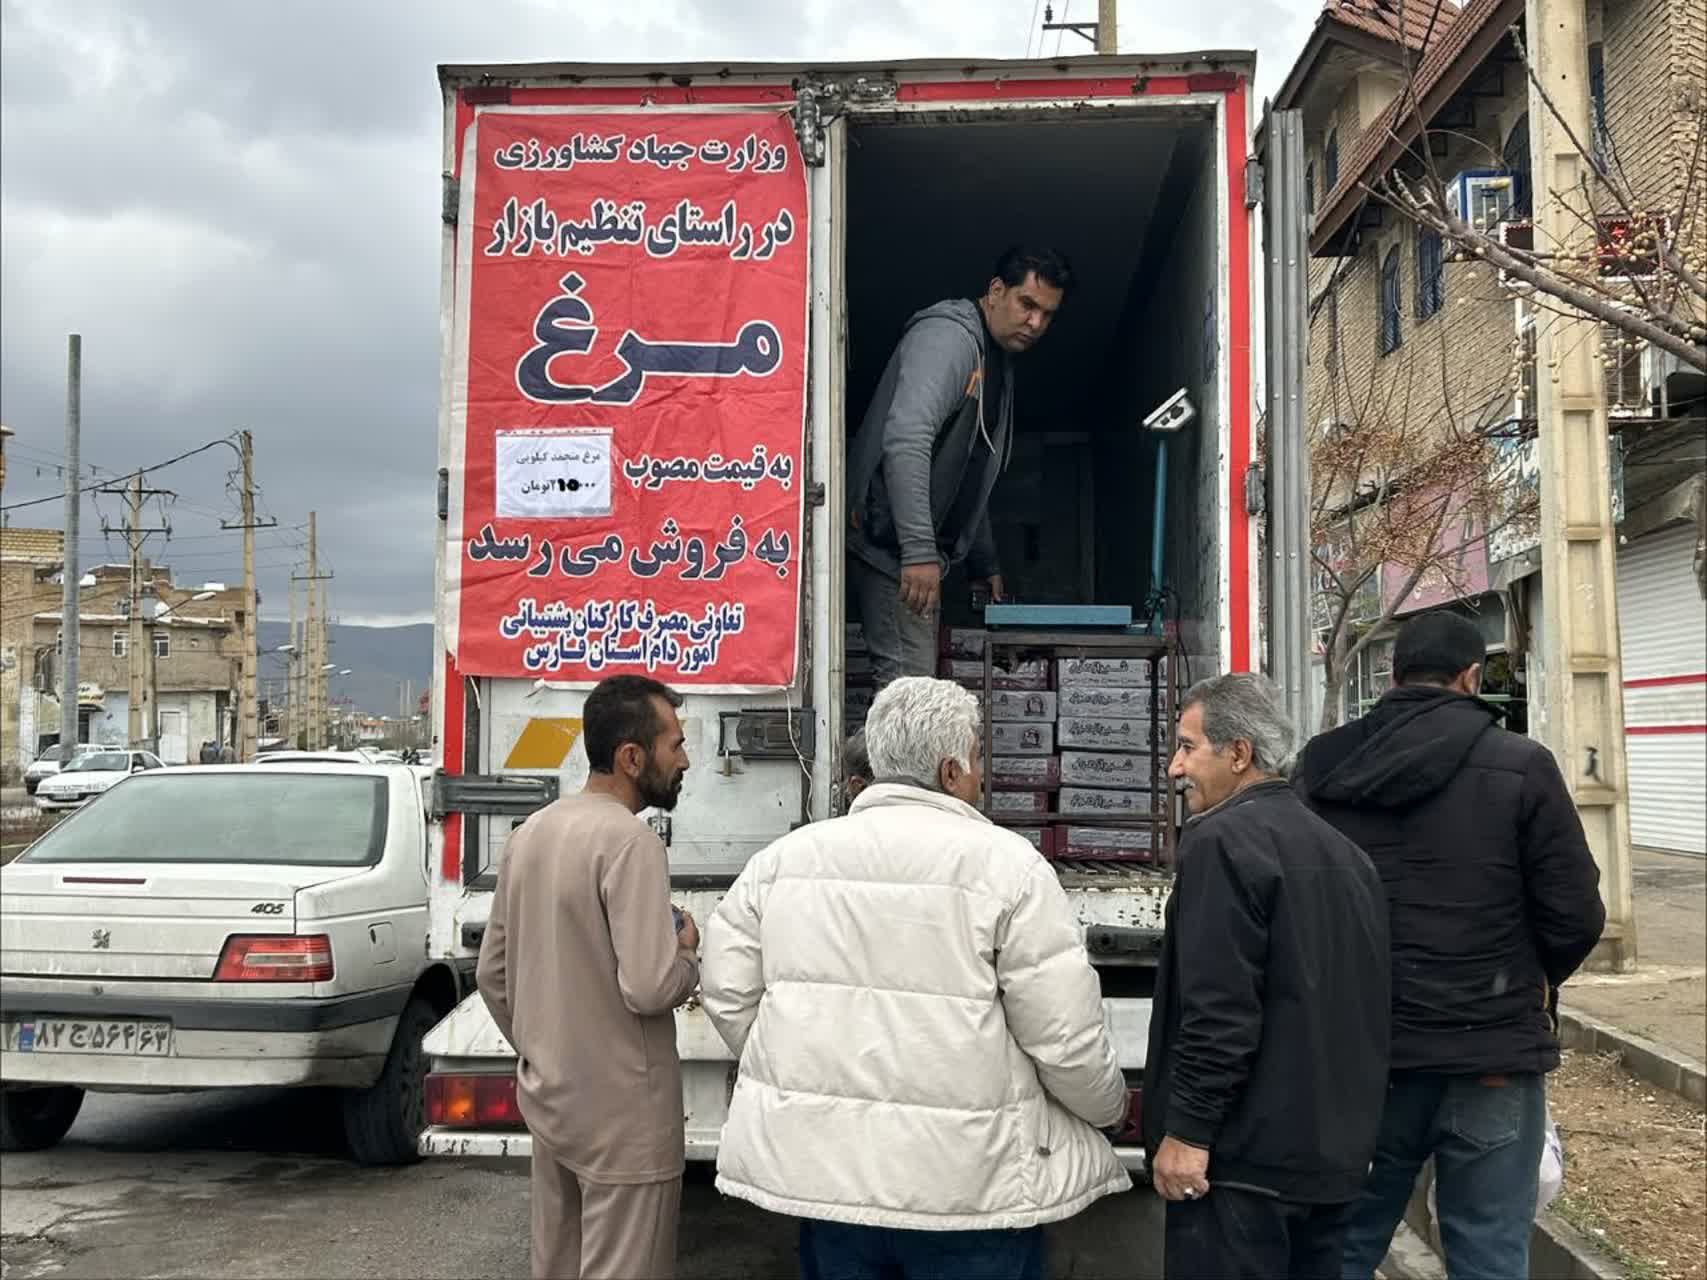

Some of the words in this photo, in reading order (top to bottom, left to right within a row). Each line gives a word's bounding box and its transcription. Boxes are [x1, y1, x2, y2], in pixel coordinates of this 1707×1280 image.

[495, 133, 623, 171] کشاورزی
[628, 136, 694, 170] جهاد
[700, 135, 787, 172] وزارت
[485, 197, 558, 256] بازار
[559, 200, 645, 256] تنظیم
[645, 199, 752, 259] راستای
[754, 209, 794, 260] در
[515, 272, 783, 404] مرغ
[624, 456, 699, 489] مصوب
[702, 446, 768, 488] قیمت
[771, 455, 793, 489] به
[560, 532, 624, 577] می
[629, 516, 748, 579] فروش
[754, 527, 791, 578] به
[501, 599, 574, 638] پشتیبانی
[636, 600, 690, 638] مصرف
[689, 602, 744, 640] تعاونی
[524, 633, 588, 669] فارس
[590, 634, 648, 668] استان
[648, 634, 680, 671] دام
[250, 903, 286, 914] 405
